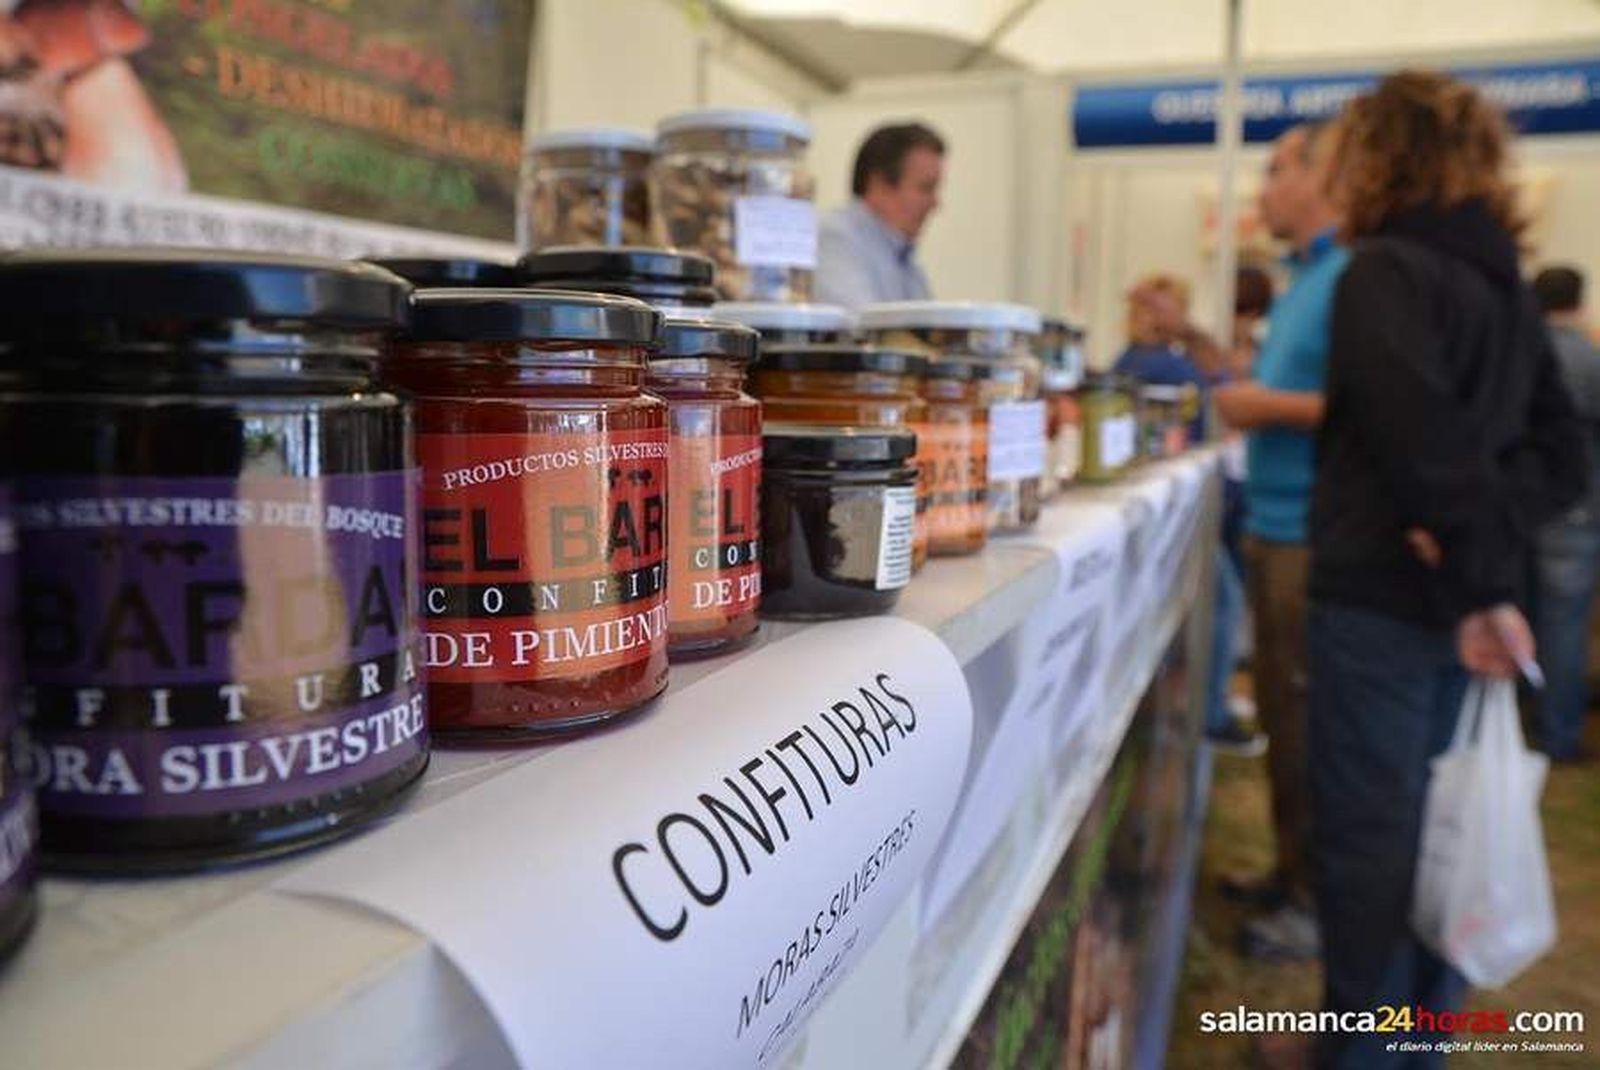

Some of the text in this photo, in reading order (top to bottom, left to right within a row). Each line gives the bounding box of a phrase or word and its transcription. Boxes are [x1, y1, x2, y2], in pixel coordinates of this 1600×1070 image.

[443, 450, 580, 490] PRODUCTOS
[58, 498, 256, 528] SILVESTRES
[262, 500, 322, 528] DEL
[326, 505, 405, 539] BOSQUE
[690, 487, 744, 536] EL
[424, 505, 520, 572] EL
[693, 579, 732, 608] DE
[427, 632, 495, 667] DE
[161, 693, 425, 794] SILVESTRE
[612, 672, 917, 943] CONFITURAS
[737, 910, 825, 1040] MORAS
[825, 809, 916, 935] SILVESTRES
